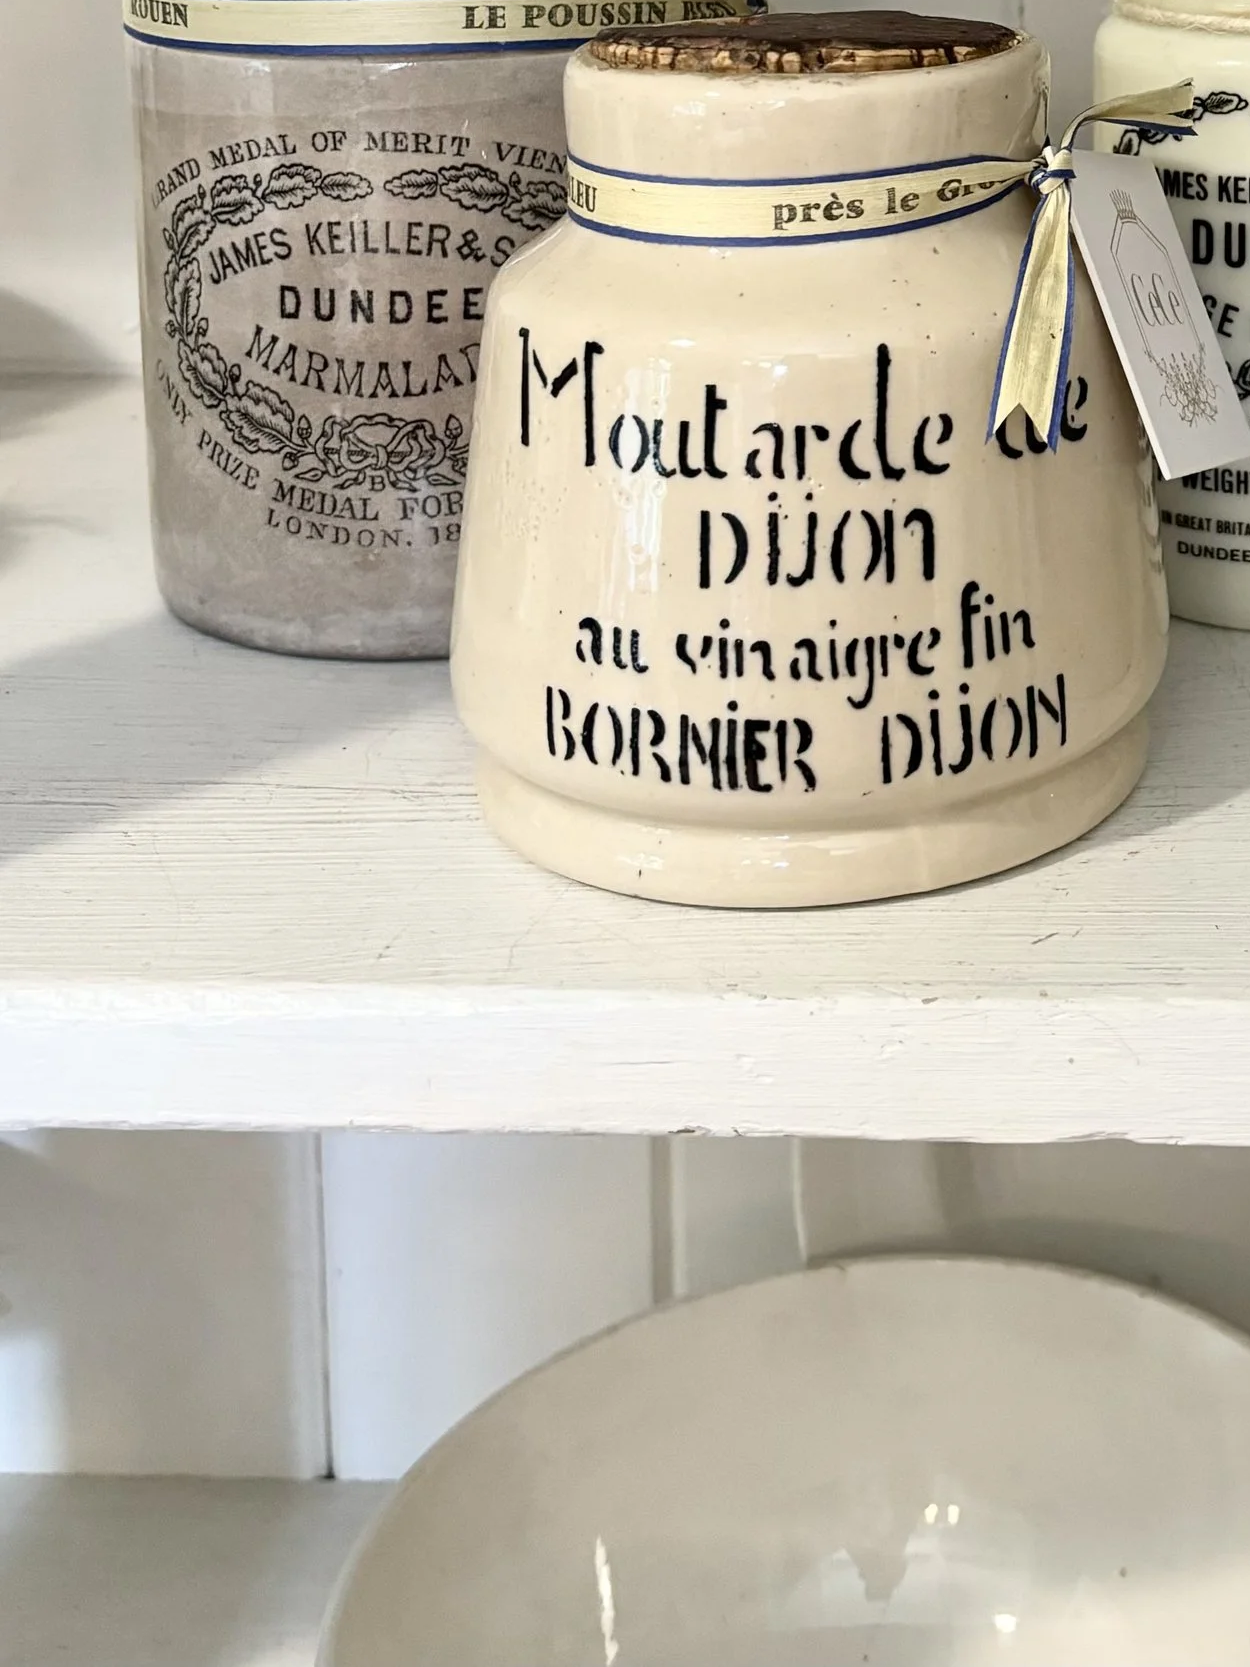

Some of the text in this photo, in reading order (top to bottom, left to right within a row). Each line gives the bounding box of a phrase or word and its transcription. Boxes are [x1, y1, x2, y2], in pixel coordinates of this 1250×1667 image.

[462, 4, 507, 30] LE
[522, 0, 667, 28] POUSSIN
[208, 134, 297, 170] MEDAL
[311, 130, 348, 153] OF
[363, 131, 471, 157] MERIT
[568, 176, 598, 213] LEU
[771, 192, 865, 231] près
[884, 187, 920, 215] le
[208, 227, 293, 285] JAMES
[304, 219, 452, 259] KEILLER
[280, 284, 484, 324] DUNDEE
[1130, 272, 1184, 327] CeCe
[518, 327, 954, 481] Moutarde
[197, 428, 260, 490] PRIZE
[271, 478, 379, 521] MEDAL
[368, 474, 387, 493] B
[1175, 512, 1212, 532] GREAT
[576, 616, 649, 674] au
[959, 580, 1036, 668] fin
